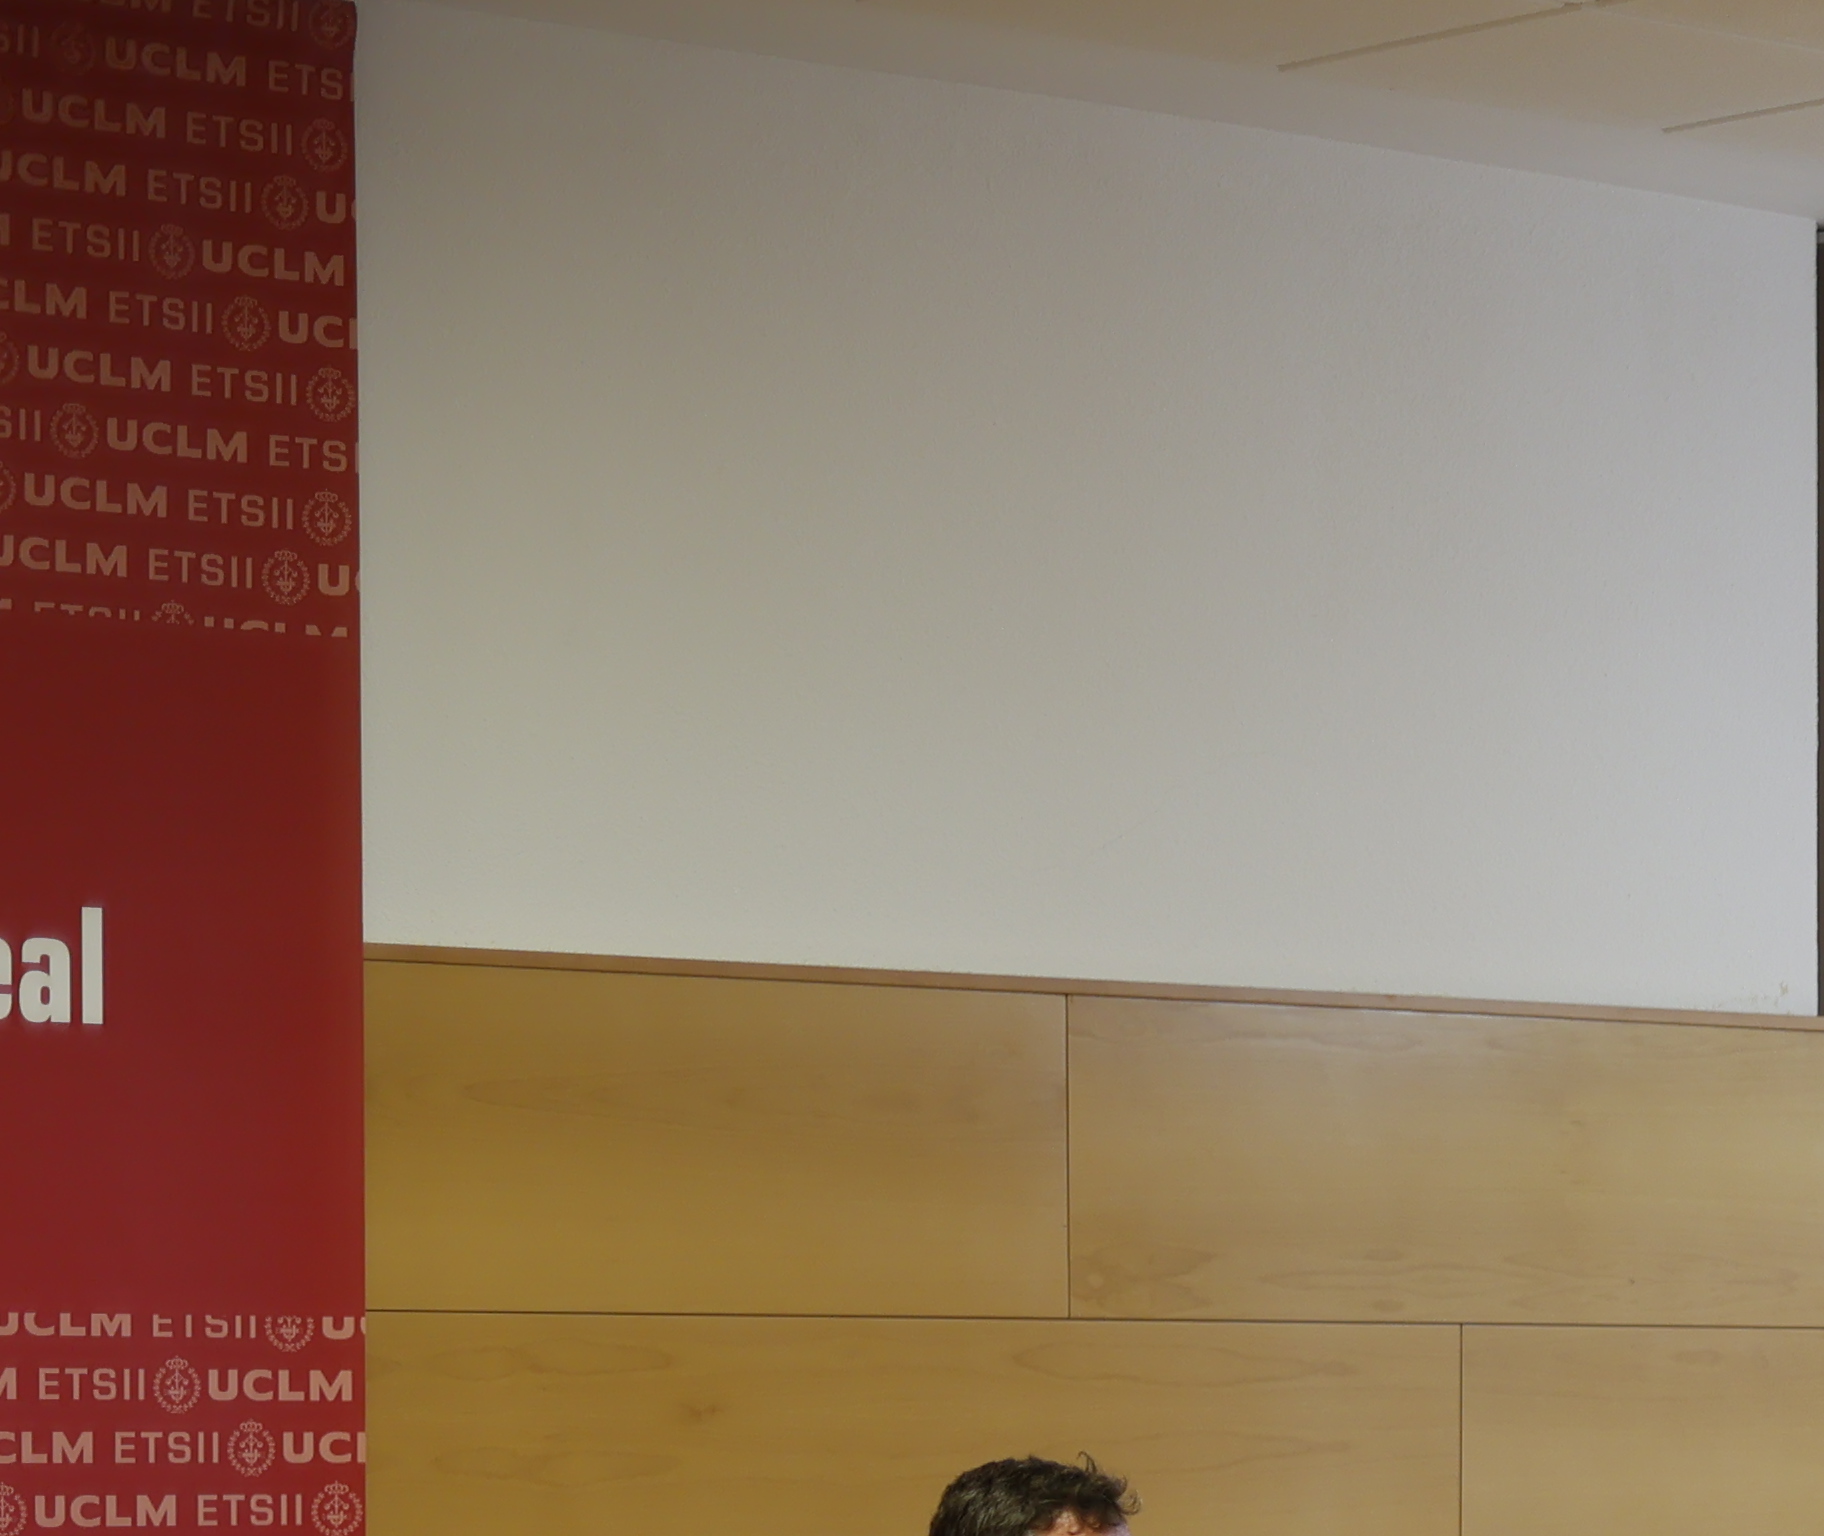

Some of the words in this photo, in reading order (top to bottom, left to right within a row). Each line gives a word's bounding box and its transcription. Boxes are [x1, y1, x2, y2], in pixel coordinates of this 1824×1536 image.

[105, 36, 247, 87] UCLM
[22, 88, 166, 139] UCLM
[186, 112, 292, 156] ETSII
[148, 168, 252, 213] ETSII
[32, 217, 139, 262] ETSII
[203, 238, 345, 287] UCLM
[109, 290, 213, 334] ETSII
[27, 344, 172, 392] UCLM
[190, 363, 297, 406] ETSII
[106, 417, 247, 463] UCLM
[24, 472, 168, 518] UCLM
[188, 489, 293, 530] ETSII
[148, 548, 253, 589] ETSII
[0, 906, 103, 1025] al
[38, 1367, 145, 1400] ETSII
[208, 1368, 353, 1402] UCLM
[114, 1431, 220, 1464] ETSII
[34, 1494, 177, 1528] UCLM
[197, 1494, 303, 1526] ETSII
